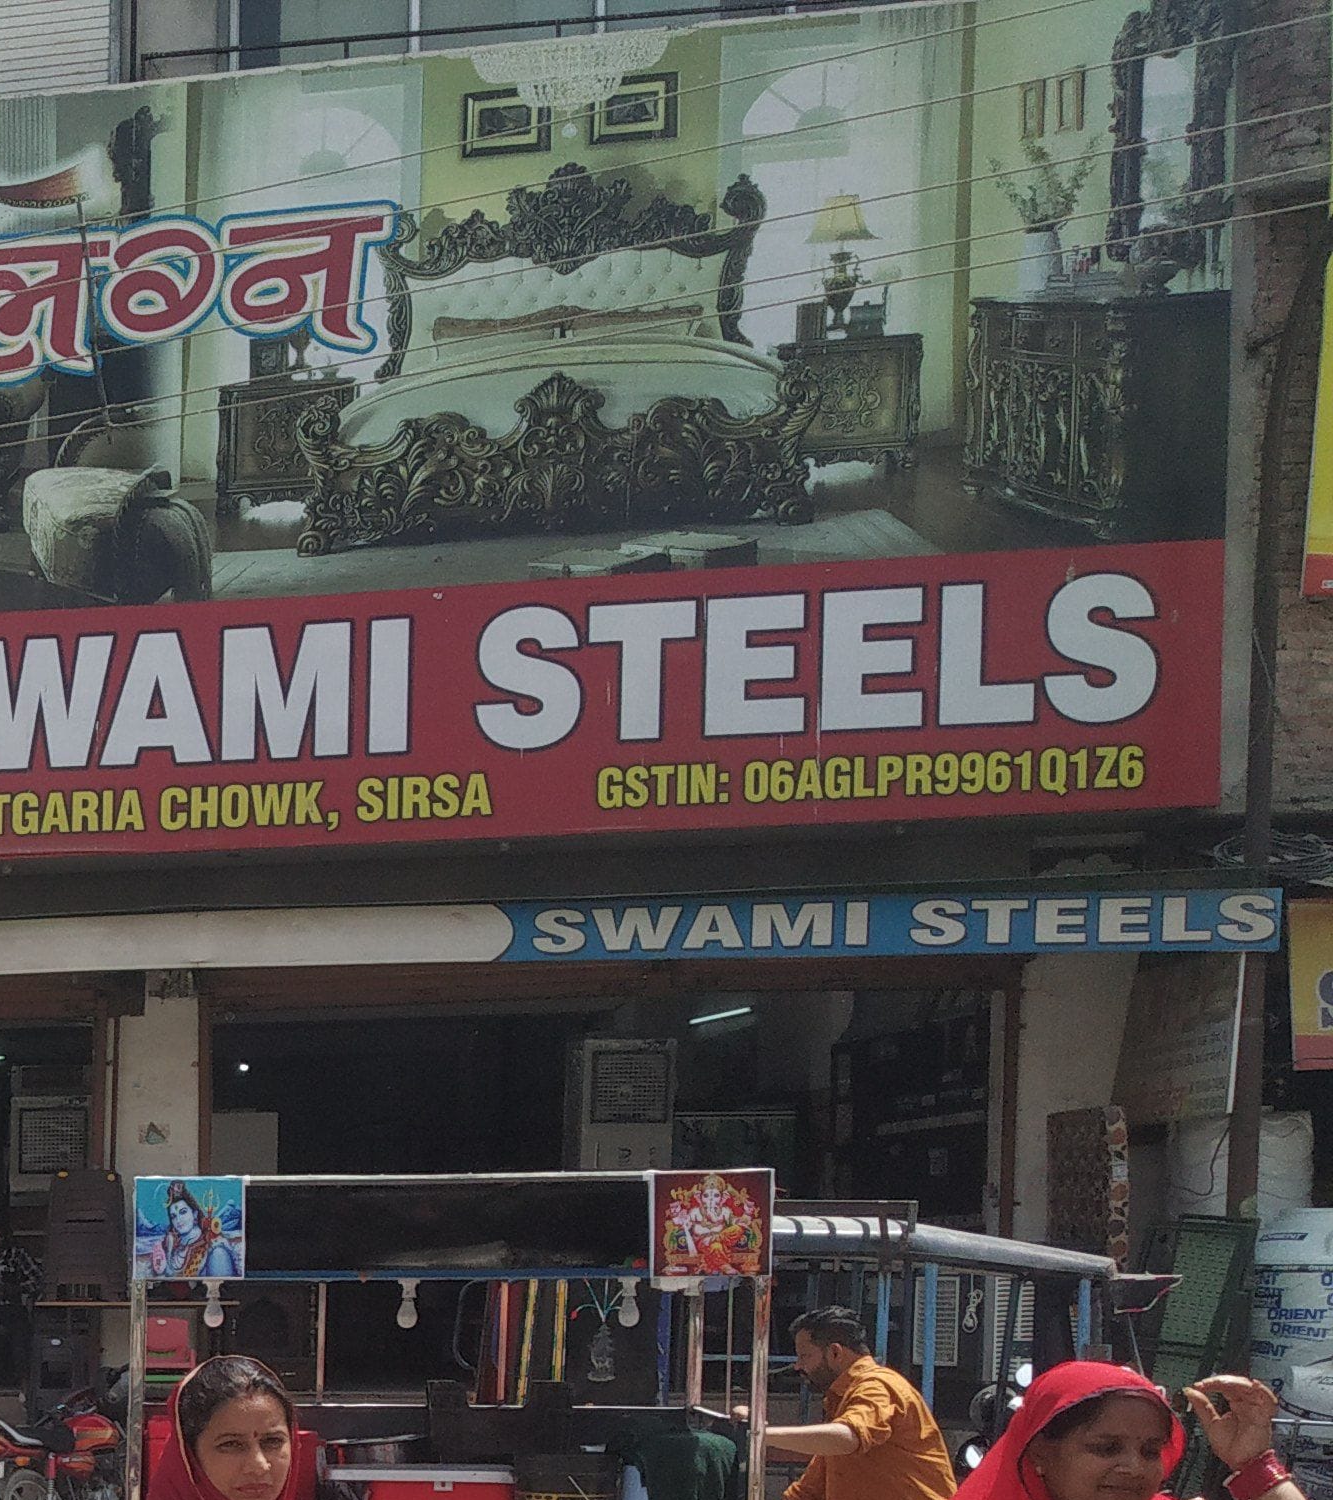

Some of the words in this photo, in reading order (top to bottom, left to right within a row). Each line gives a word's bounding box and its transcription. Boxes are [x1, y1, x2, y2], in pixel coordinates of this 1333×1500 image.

[474, 572, 1158, 750] STEELS
[159, 780, 340, 832] CHOWK,
[356, 772, 493, 824] SIRSA
[596, 763, 730, 809] GSTIN:
[743, 744, 1146, 804] 06AGLPR9961Q1Z6
[532, 900, 869, 953] SWAMI
[909, 894, 1277, 946] STEELS
[1267, 1308, 1328, 1320] ORIENT
[1270, 1322, 1331, 1338] ORIENT
